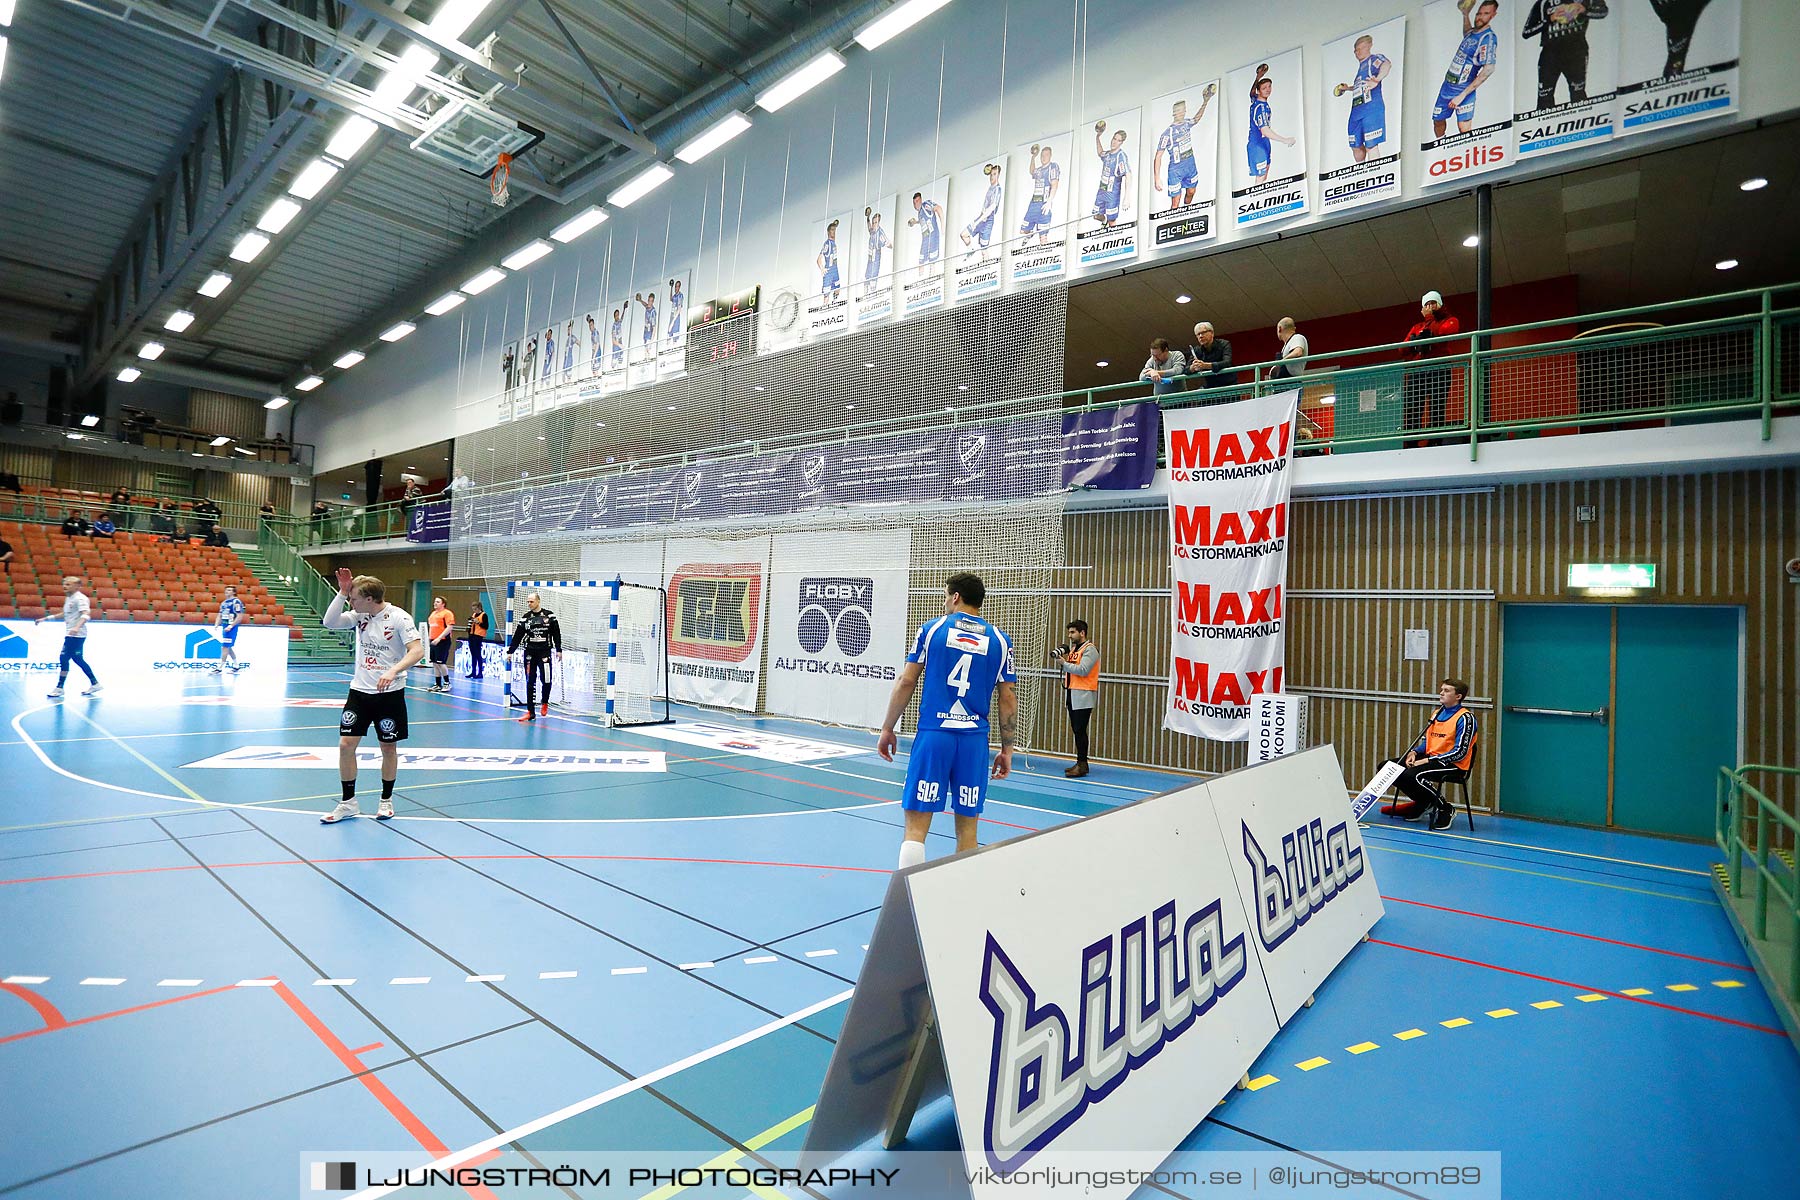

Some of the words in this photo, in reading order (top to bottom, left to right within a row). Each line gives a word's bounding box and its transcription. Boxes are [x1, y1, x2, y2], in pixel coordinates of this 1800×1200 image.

[1669, 68, 1711, 82] Ahlmark
[1531, 104, 1565, 117] Michael
[1566, 93, 1615, 109] Andersson
[1440, 132, 1470, 145] Rasmus
[1337, 166, 1352, 175] Axel
[1353, 157, 1393, 171] Magnusson
[1429, 145, 1504, 177] asitis
[1265, 178, 1293, 189] Dahlman
[1325, 173, 1395, 198] CEMENTA
[1171, 421, 1290, 469] MAXI
[1171, 470, 1190, 482] ICA
[1191, 458, 1287, 482] STORMARKNAD
[1174, 502, 1286, 546] MAXI
[1174, 545, 1190, 559] ICA
[1191, 540, 1285, 560] STORMARKNAD
[806, 584, 868, 600] FLOBY
[1177, 581, 1282, 625] MAXI
[365, 657, 378, 665] ICA
[775, 656, 897, 681] AUTOKAROSS
[946, 653, 973, 698] 4
[936, 711, 980, 721] ERLANDSSON
[1173, 697, 1190, 714] ICA
[1191, 703, 1251, 720] STORMAR
[1259, 700, 1272, 761] MODERN
[1274, 700, 1286, 758] KONOMI
[354, 752, 651, 766] Myresjöhus
[916, 779, 940, 803] SLA
[1371, 765, 1398, 795] konsult
[959, 785, 980, 808] SLA
[1241, 817, 1364, 953] bilia
[979, 898, 1248, 1178] bilia
